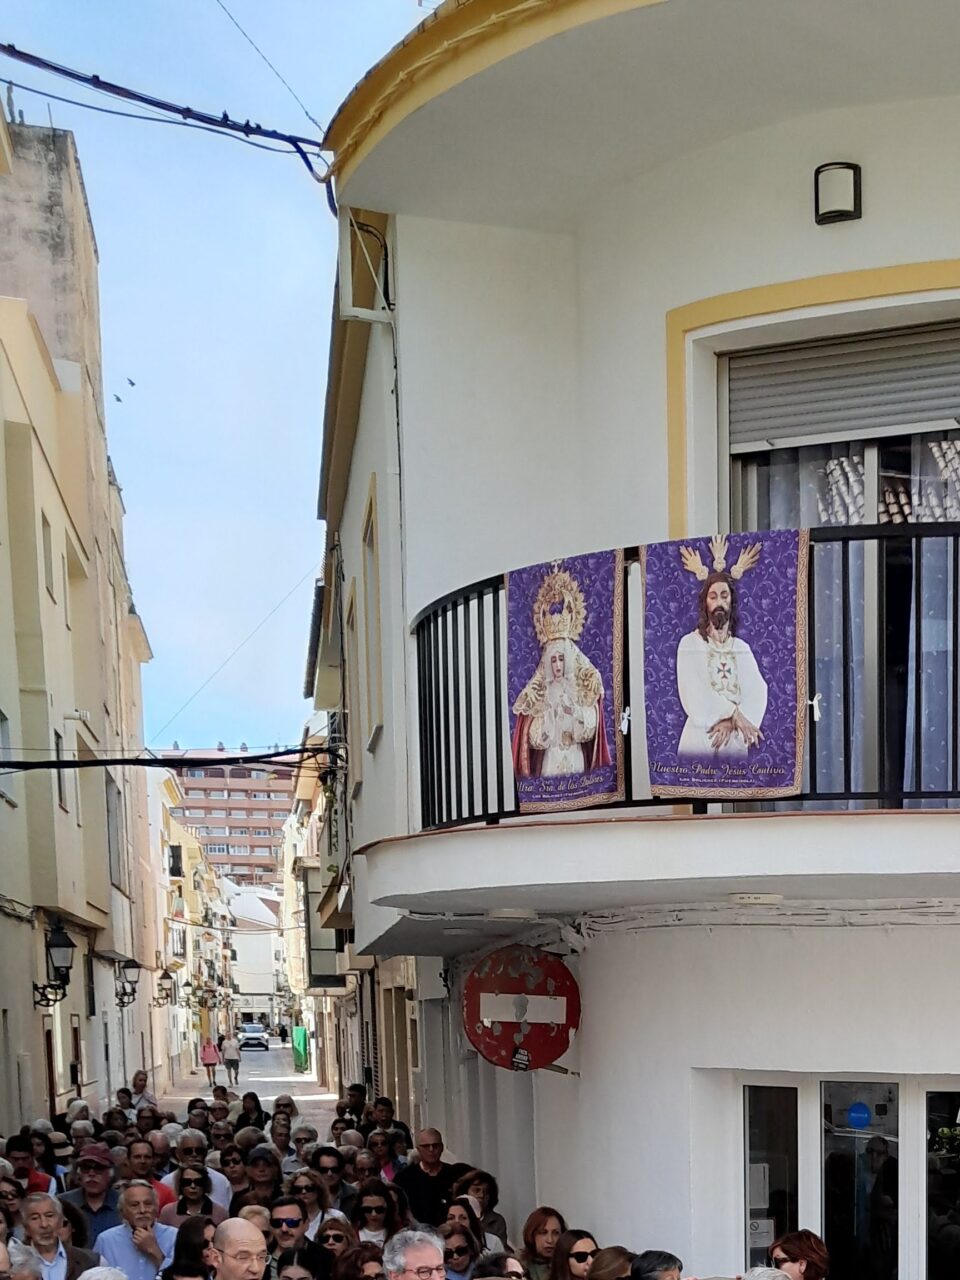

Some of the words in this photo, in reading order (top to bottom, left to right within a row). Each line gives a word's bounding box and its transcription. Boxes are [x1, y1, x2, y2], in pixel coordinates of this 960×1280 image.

[650, 761, 688, 775] Nuestro
[691, 761, 718, 774] Padre
[749, 763, 785, 775] Cautivo
